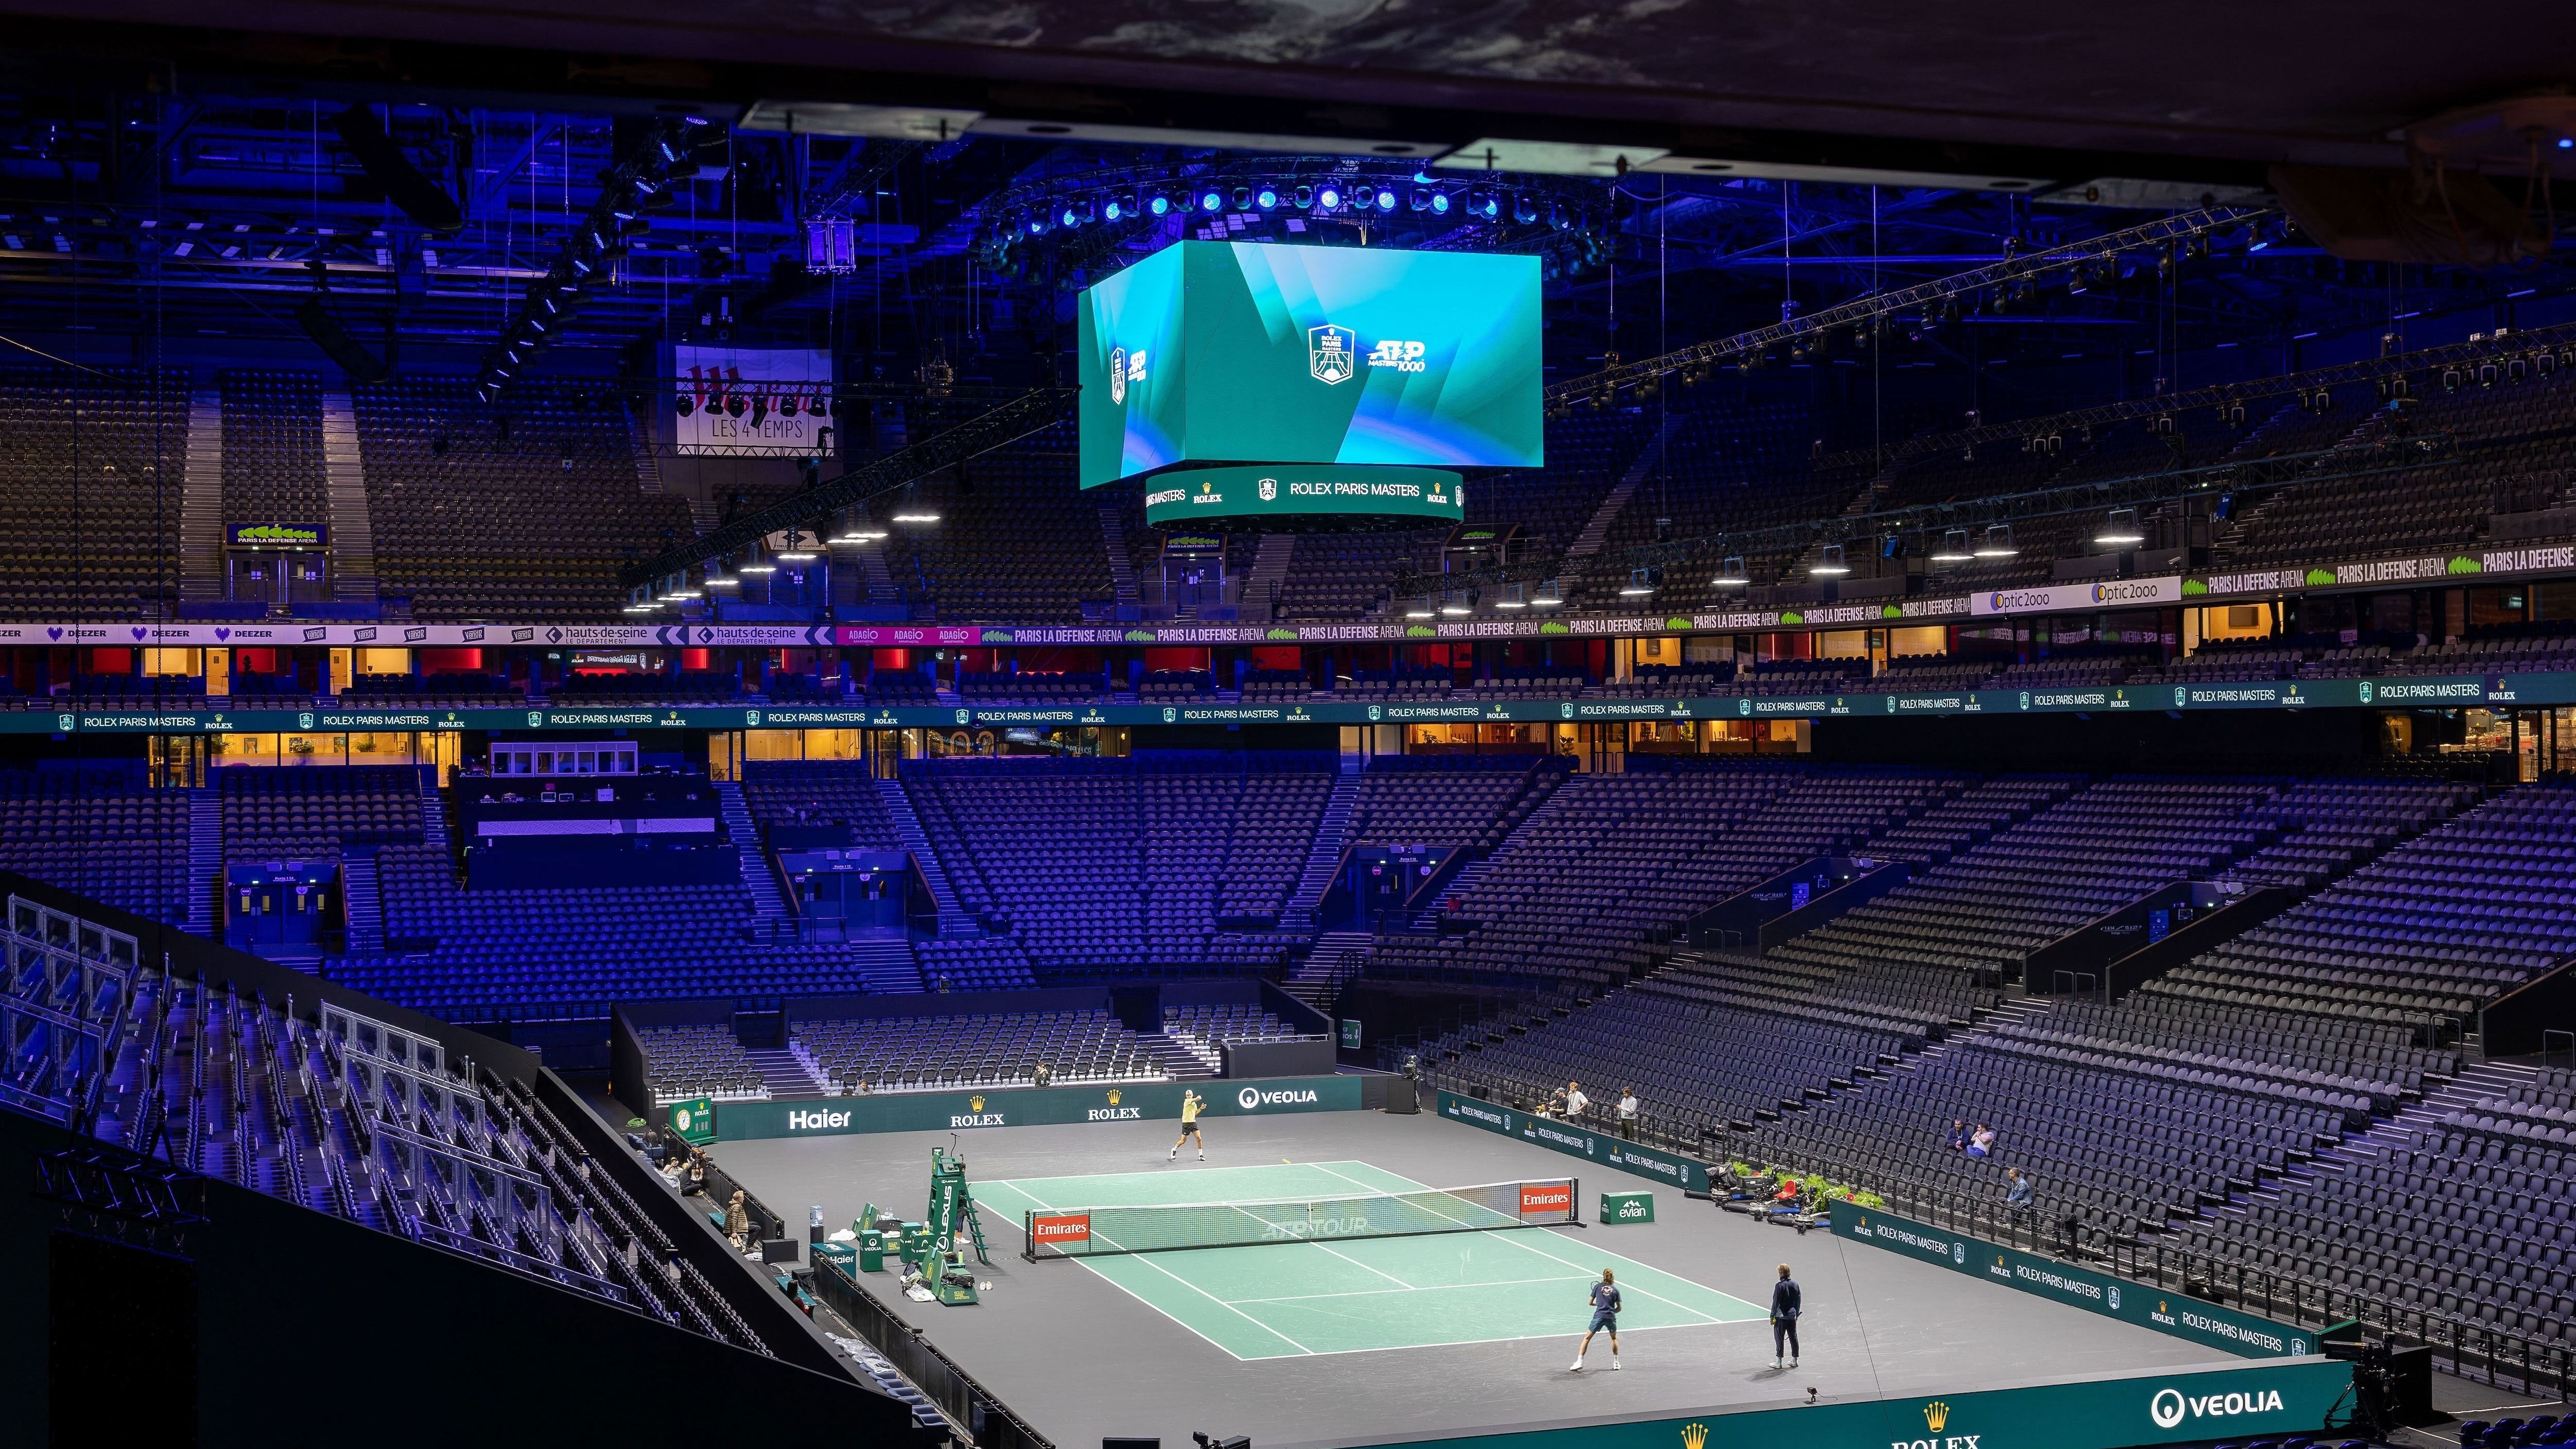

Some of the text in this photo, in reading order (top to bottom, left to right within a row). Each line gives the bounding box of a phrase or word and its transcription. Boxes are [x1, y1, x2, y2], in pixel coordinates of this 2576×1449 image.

[1366, 340, 1425, 360] ATP
[1398, 361, 1425, 372] 1000
[713, 419, 737, 437] LES
[742, 420, 750, 437] 4
[1155, 489, 1185, 504] MASTERS
[1291, 483, 1419, 497] ROLEX PARIS MASTERS
[1194, 492, 1222, 503] ROLEX
[1427, 495, 1447, 503] ROLEX
[2484, 547, 2574, 572] PARIS LA DEFENSE
[2337, 557, 2446, 584] PARIS LA DEFENSE ARENA
[2209, 570, 2304, 593] PARIS LA DEFENSE ARENA
[2098, 583, 2158, 605] Optic 2000
[1996, 591, 2049, 614] Optic 2000
[1570, 618, 1665, 633] PARIS LA DEFENSE ARENA
[1694, 612, 1779, 628] PARIS LA DEFENSE ARENA
[1300, 625, 1404, 639] PARIS LA DEFENSE ARENA
[1438, 622, 1538, 636] PARIS LA DEFENSE ARENA
[1015, 630, 1122, 642] PARIS LA DEFENSE ARENA
[2193, 690, 2275, 701] ROLEX PARIS MASTERS
[2381, 684, 2479, 697] ROLEX PARIS MASTERS
[1240, 710, 1278, 718] MASTERS
[1632, 705, 1664, 713] MASTERS
[85, 718, 195, 726] ROLEX PARIS MASTERS
[324, 716, 429, 725] ROLEX PARIS MASTERS
[1261, 1090, 1317, 1103] VEOLIA
[789, 1109, 851, 1130] Haier
[951, 1114, 1004, 1127] ROLEX
[1088, 1108, 1141, 1120] ROLEX
[1539, 1128, 1583, 1148] ROLEX PARIS MASTERS
[1610, 1154, 1622, 1163] ROLEX
[1626, 1153, 1676, 1175] ROLEX PARIS MASTERS
[1523, 1193, 1568, 1205] Emirates
[940, 1185, 952, 1235] LEXUS
[1619, 1206, 1646, 1218] evian
[1038, 1223, 1087, 1235] Emirates
[1855, 1226, 1872, 1236] ROLEX
[1877, 1225, 1947, 1254] ROLEX PARIS MASTERS
[1991, 1266, 2010, 1277] ROLEX
[2018, 1265, 2100, 1299] ROLEX PARIS MASTERS
[2151, 1312, 2175, 1325] ROLEX
[2183, 1312, 2282, 1351] ROLEX PARIS MASTERS
[2189, 1390, 2284, 1417] VEOLIA
[1892, 1436, 1980, 1449] ROLEX
